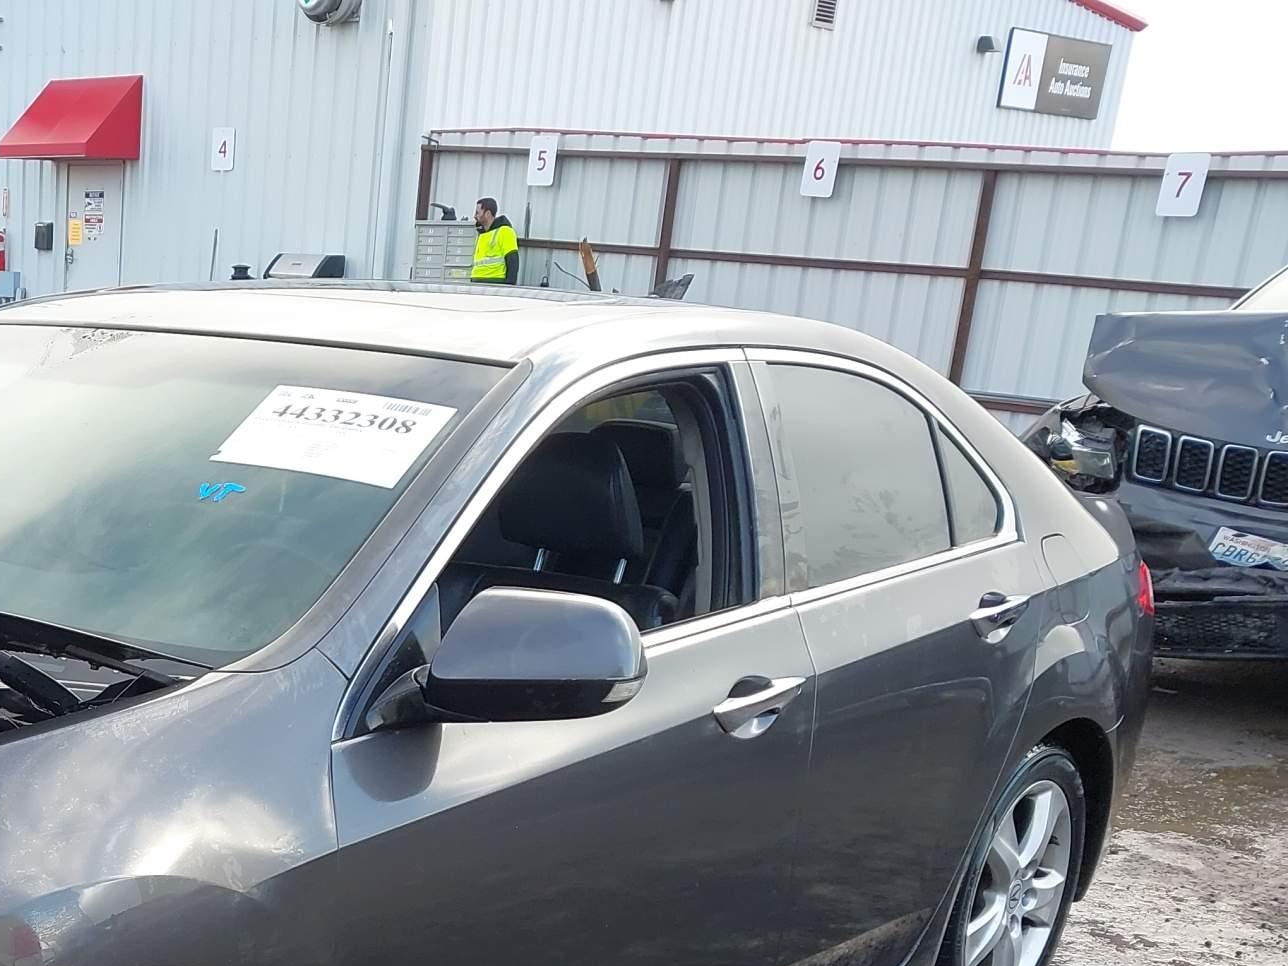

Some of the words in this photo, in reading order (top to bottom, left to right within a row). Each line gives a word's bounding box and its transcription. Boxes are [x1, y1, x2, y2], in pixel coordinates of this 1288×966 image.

[1057, 58, 1090, 78] Insurance
[1048, 78, 1065, 95] Auto
[1064, 80, 1092, 98] Auctions
[218, 139, 227, 158] 4
[536, 149, 548, 172] 5
[813, 157, 825, 181] 6
[1175, 171, 1193, 198] 7
[272, 403, 417, 434] 44332308
